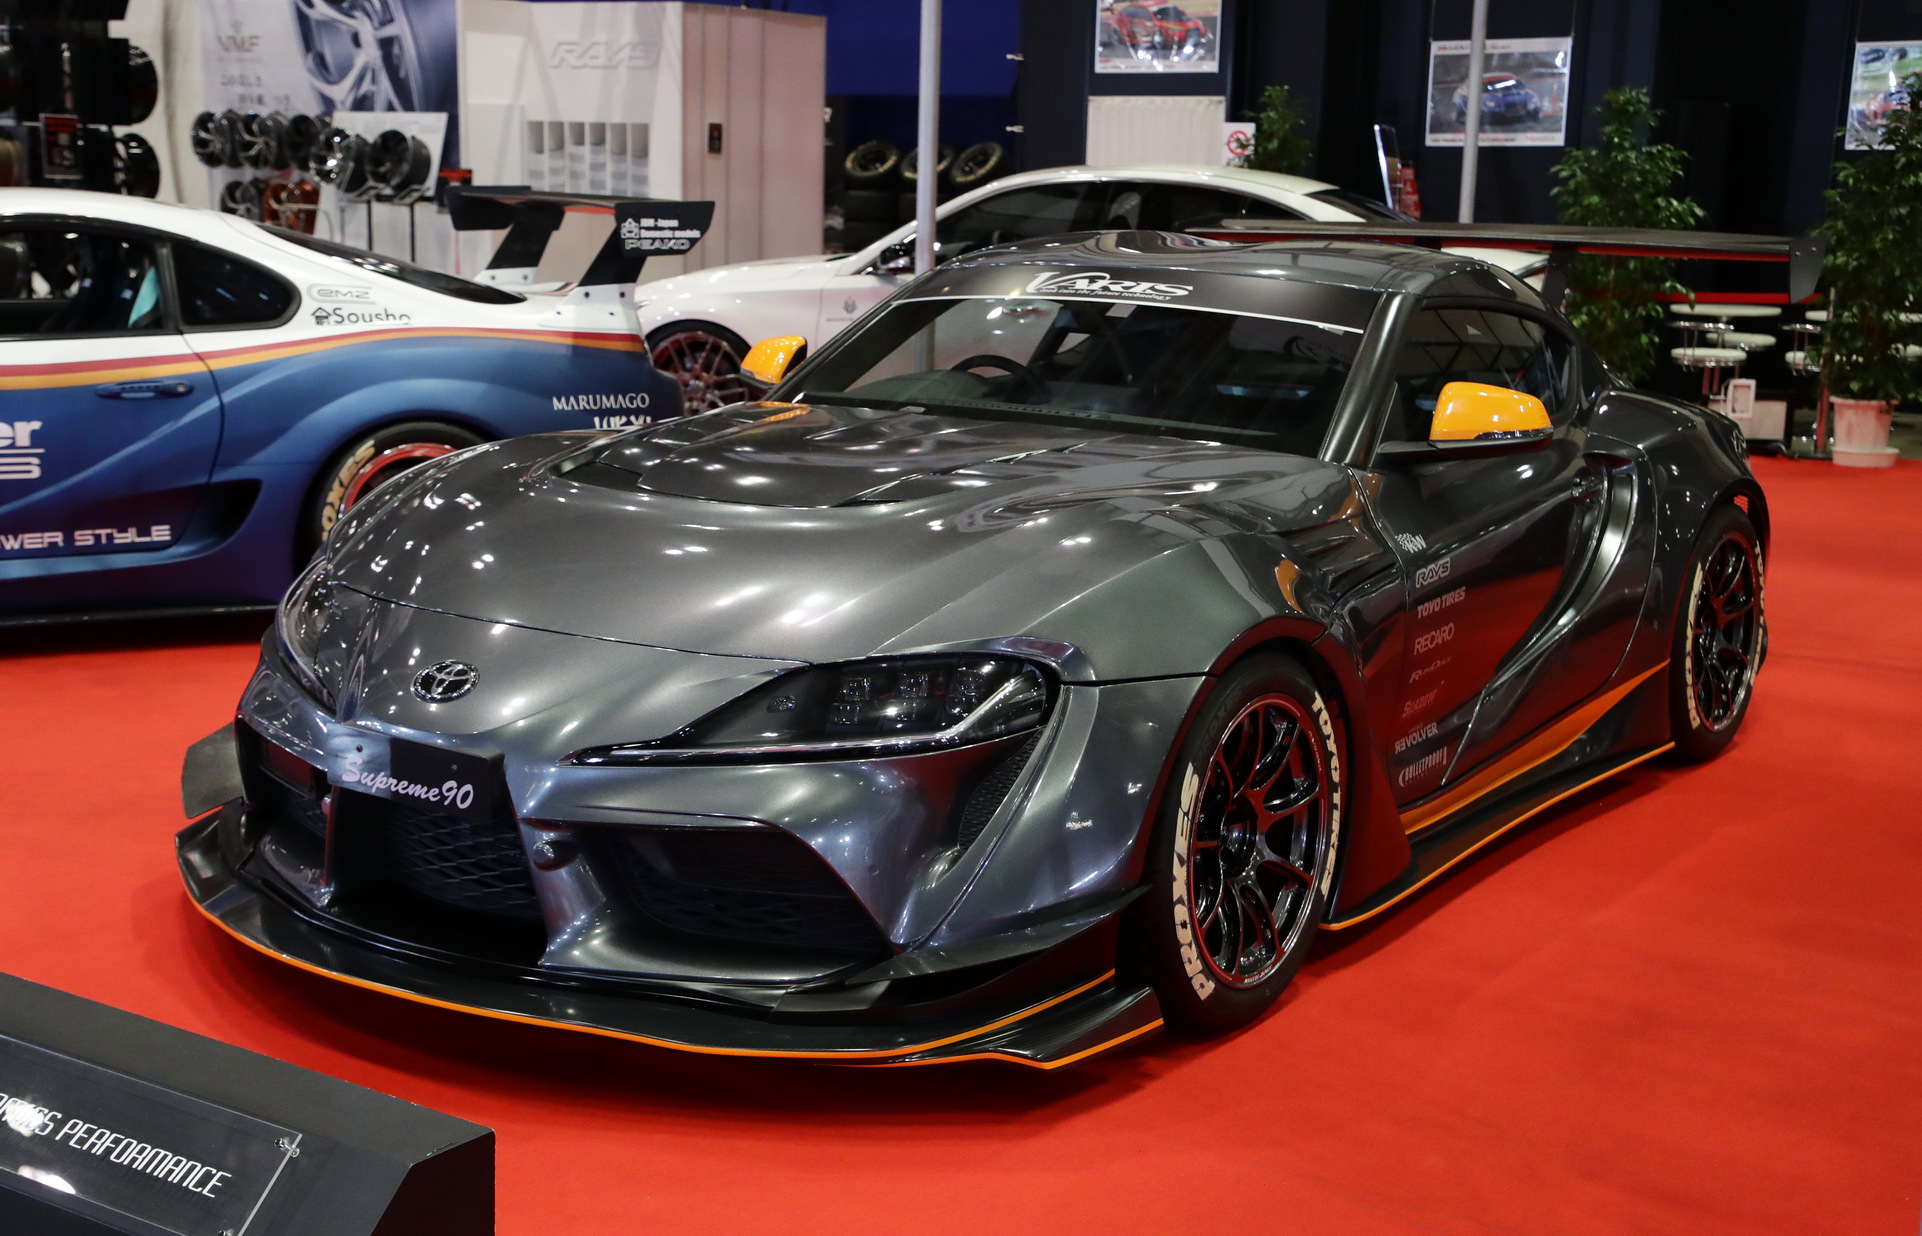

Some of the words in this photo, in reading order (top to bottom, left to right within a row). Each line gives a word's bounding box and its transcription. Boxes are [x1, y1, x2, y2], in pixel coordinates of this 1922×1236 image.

[1077, 288, 1091, 296] the
[552, 392, 650, 411] MARUMAGO
[0, 531, 64, 550] WER
[73, 524, 172, 547] STYLE
[1415, 557, 1451, 589] RAYS
[1417, 597, 1441, 619] TOYO
[1440, 586, 1466, 609] TIRES
[1413, 622, 1455, 656] RECARO
[1311, 690, 1341, 784] TOYO
[341, 755, 474, 809] Supreme90
[1172, 761, 1216, 1001] PROXES
[55, 1118, 232, 1198] PERFORMANCE
